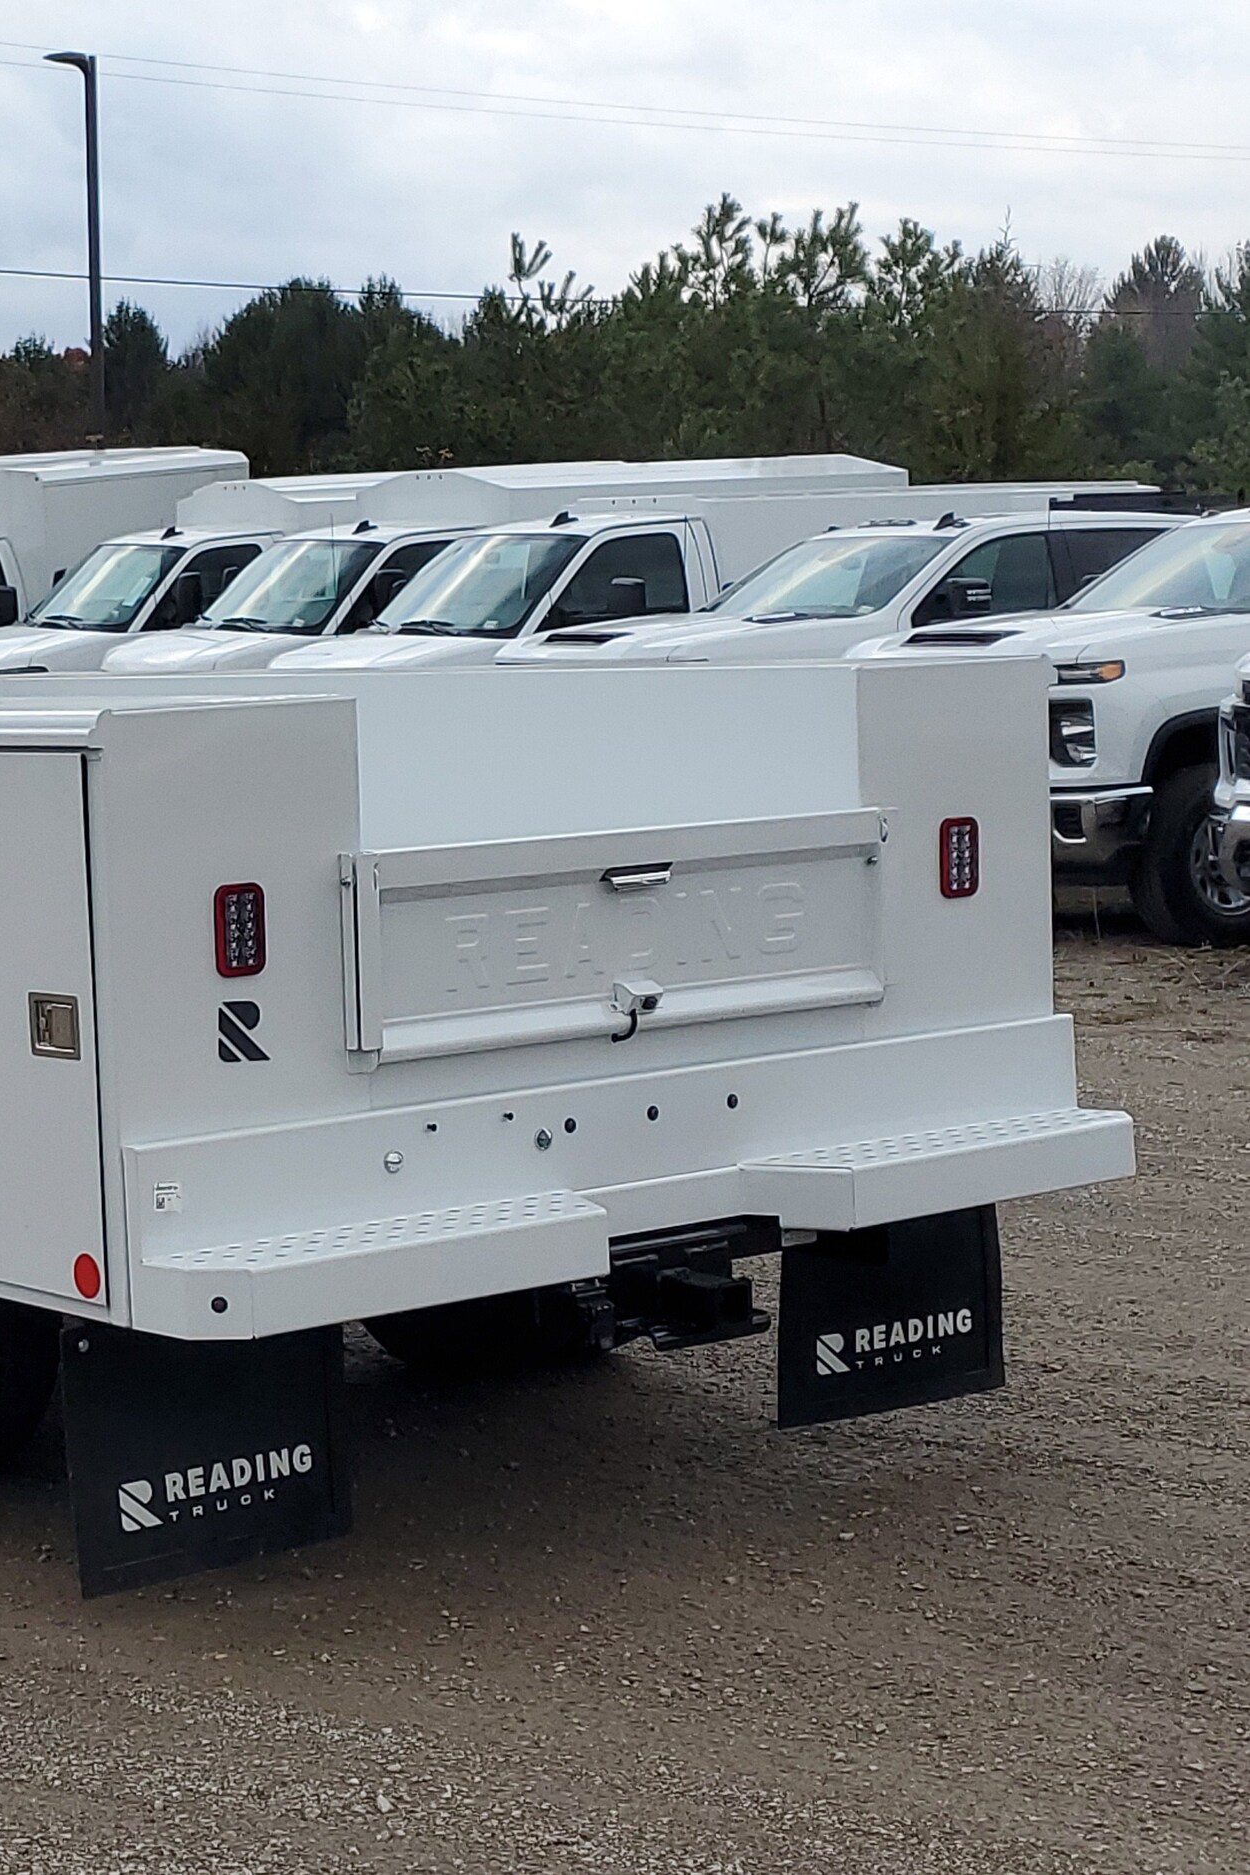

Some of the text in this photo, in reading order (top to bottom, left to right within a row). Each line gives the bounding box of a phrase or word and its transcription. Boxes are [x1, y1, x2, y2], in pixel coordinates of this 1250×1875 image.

[855, 1308, 972, 1353] READING
[855, 1345, 941, 1369] TRUCK
[164, 1444, 313, 1503] READING
[169, 1489, 275, 1522] TRUCK
